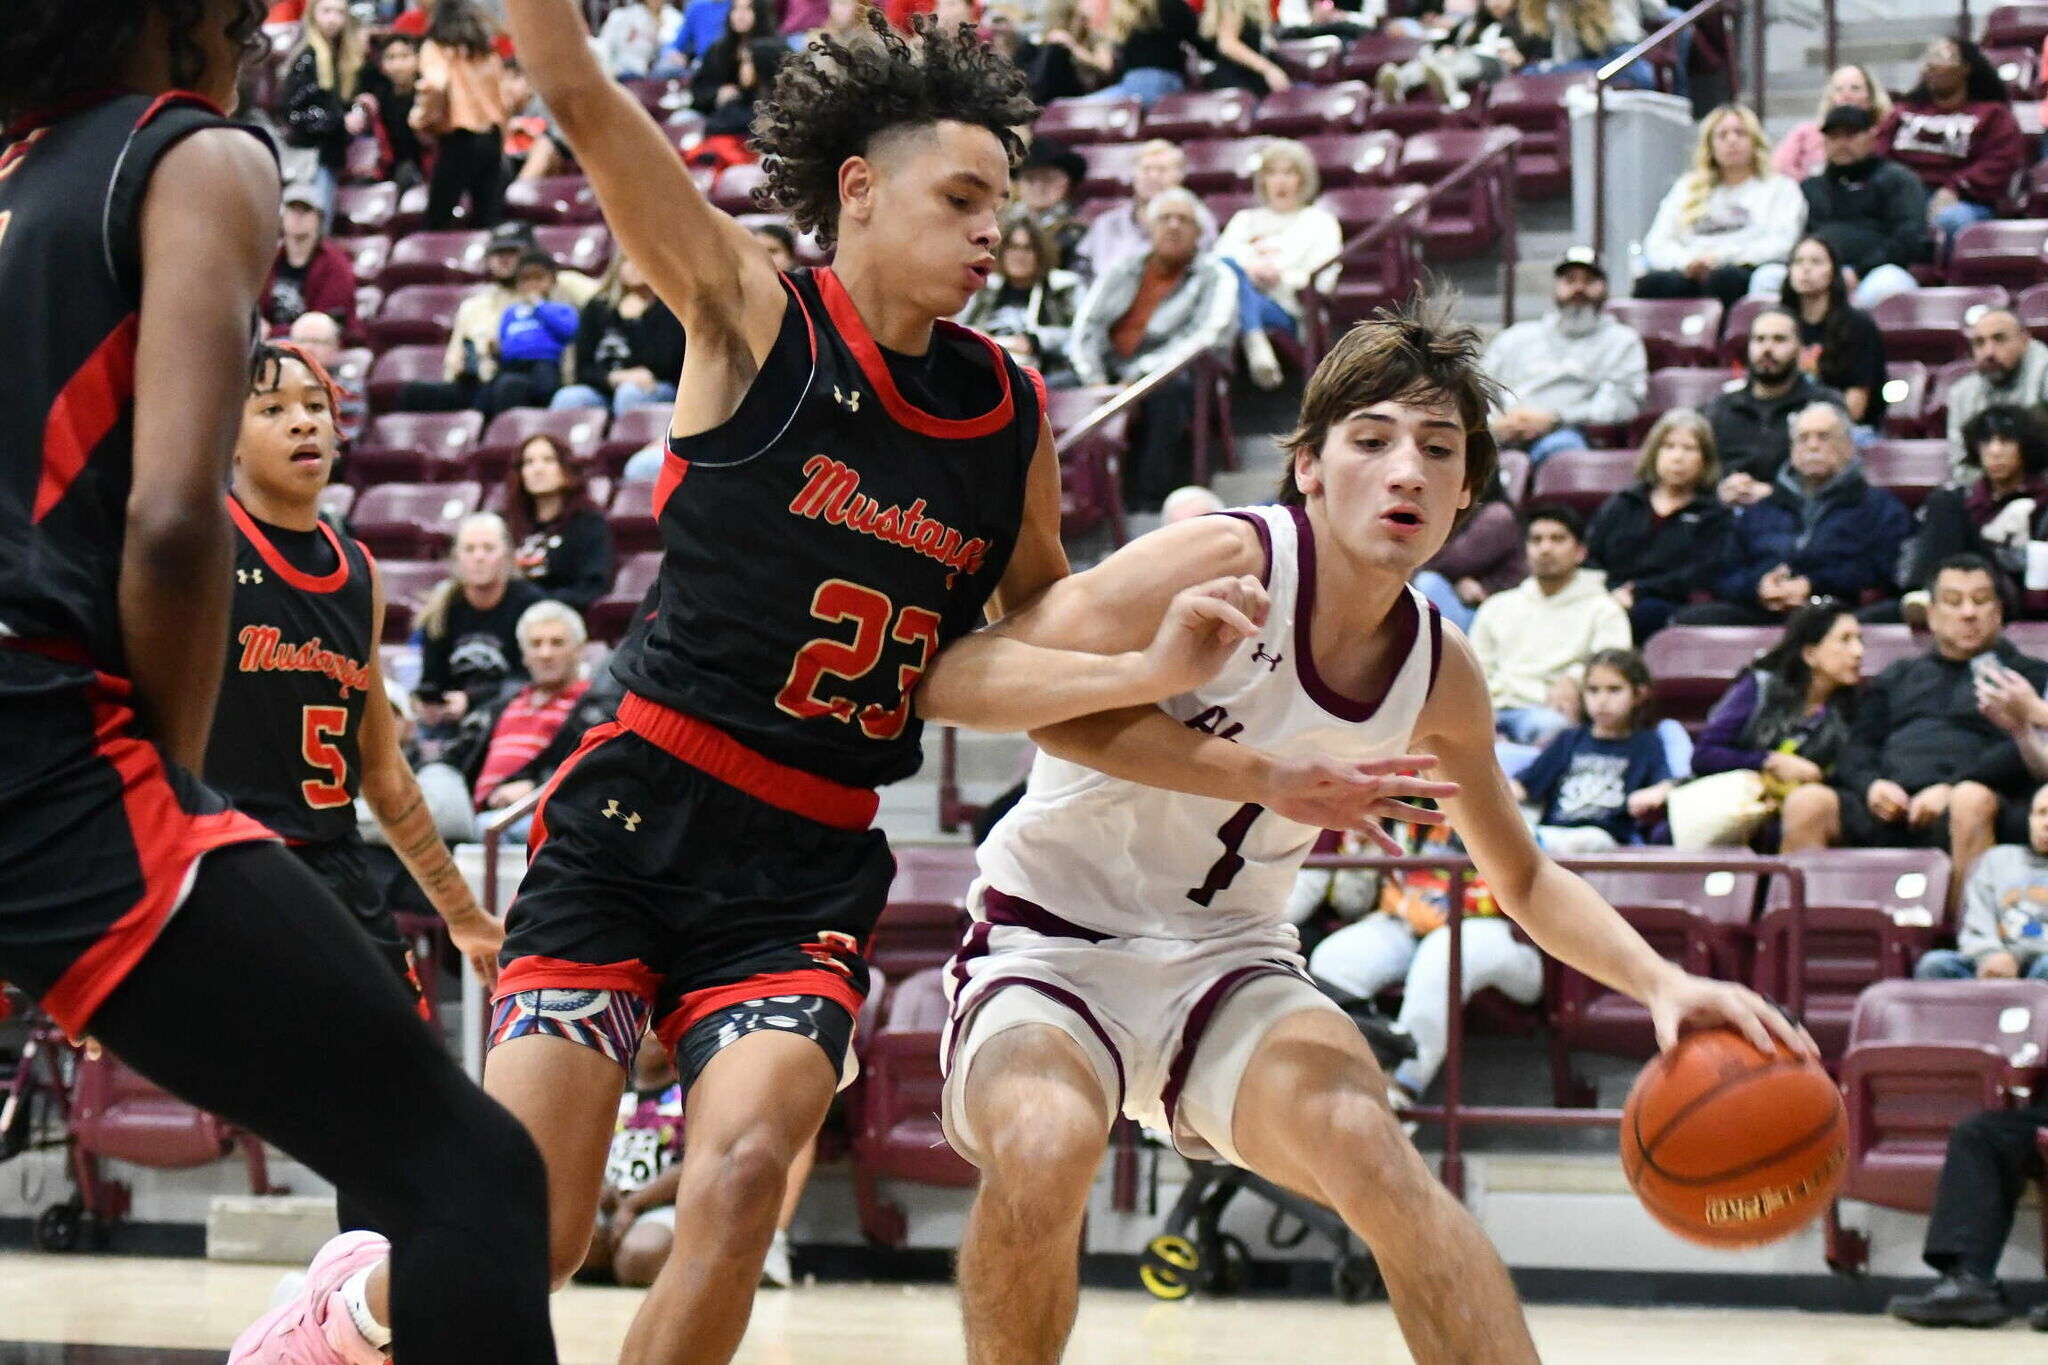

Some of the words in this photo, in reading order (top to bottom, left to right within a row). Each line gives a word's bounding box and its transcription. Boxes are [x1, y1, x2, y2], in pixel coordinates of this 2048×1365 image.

[775, 578, 942, 740] 23
[302, 705, 351, 809] 5
[1186, 802, 1265, 908] 1
